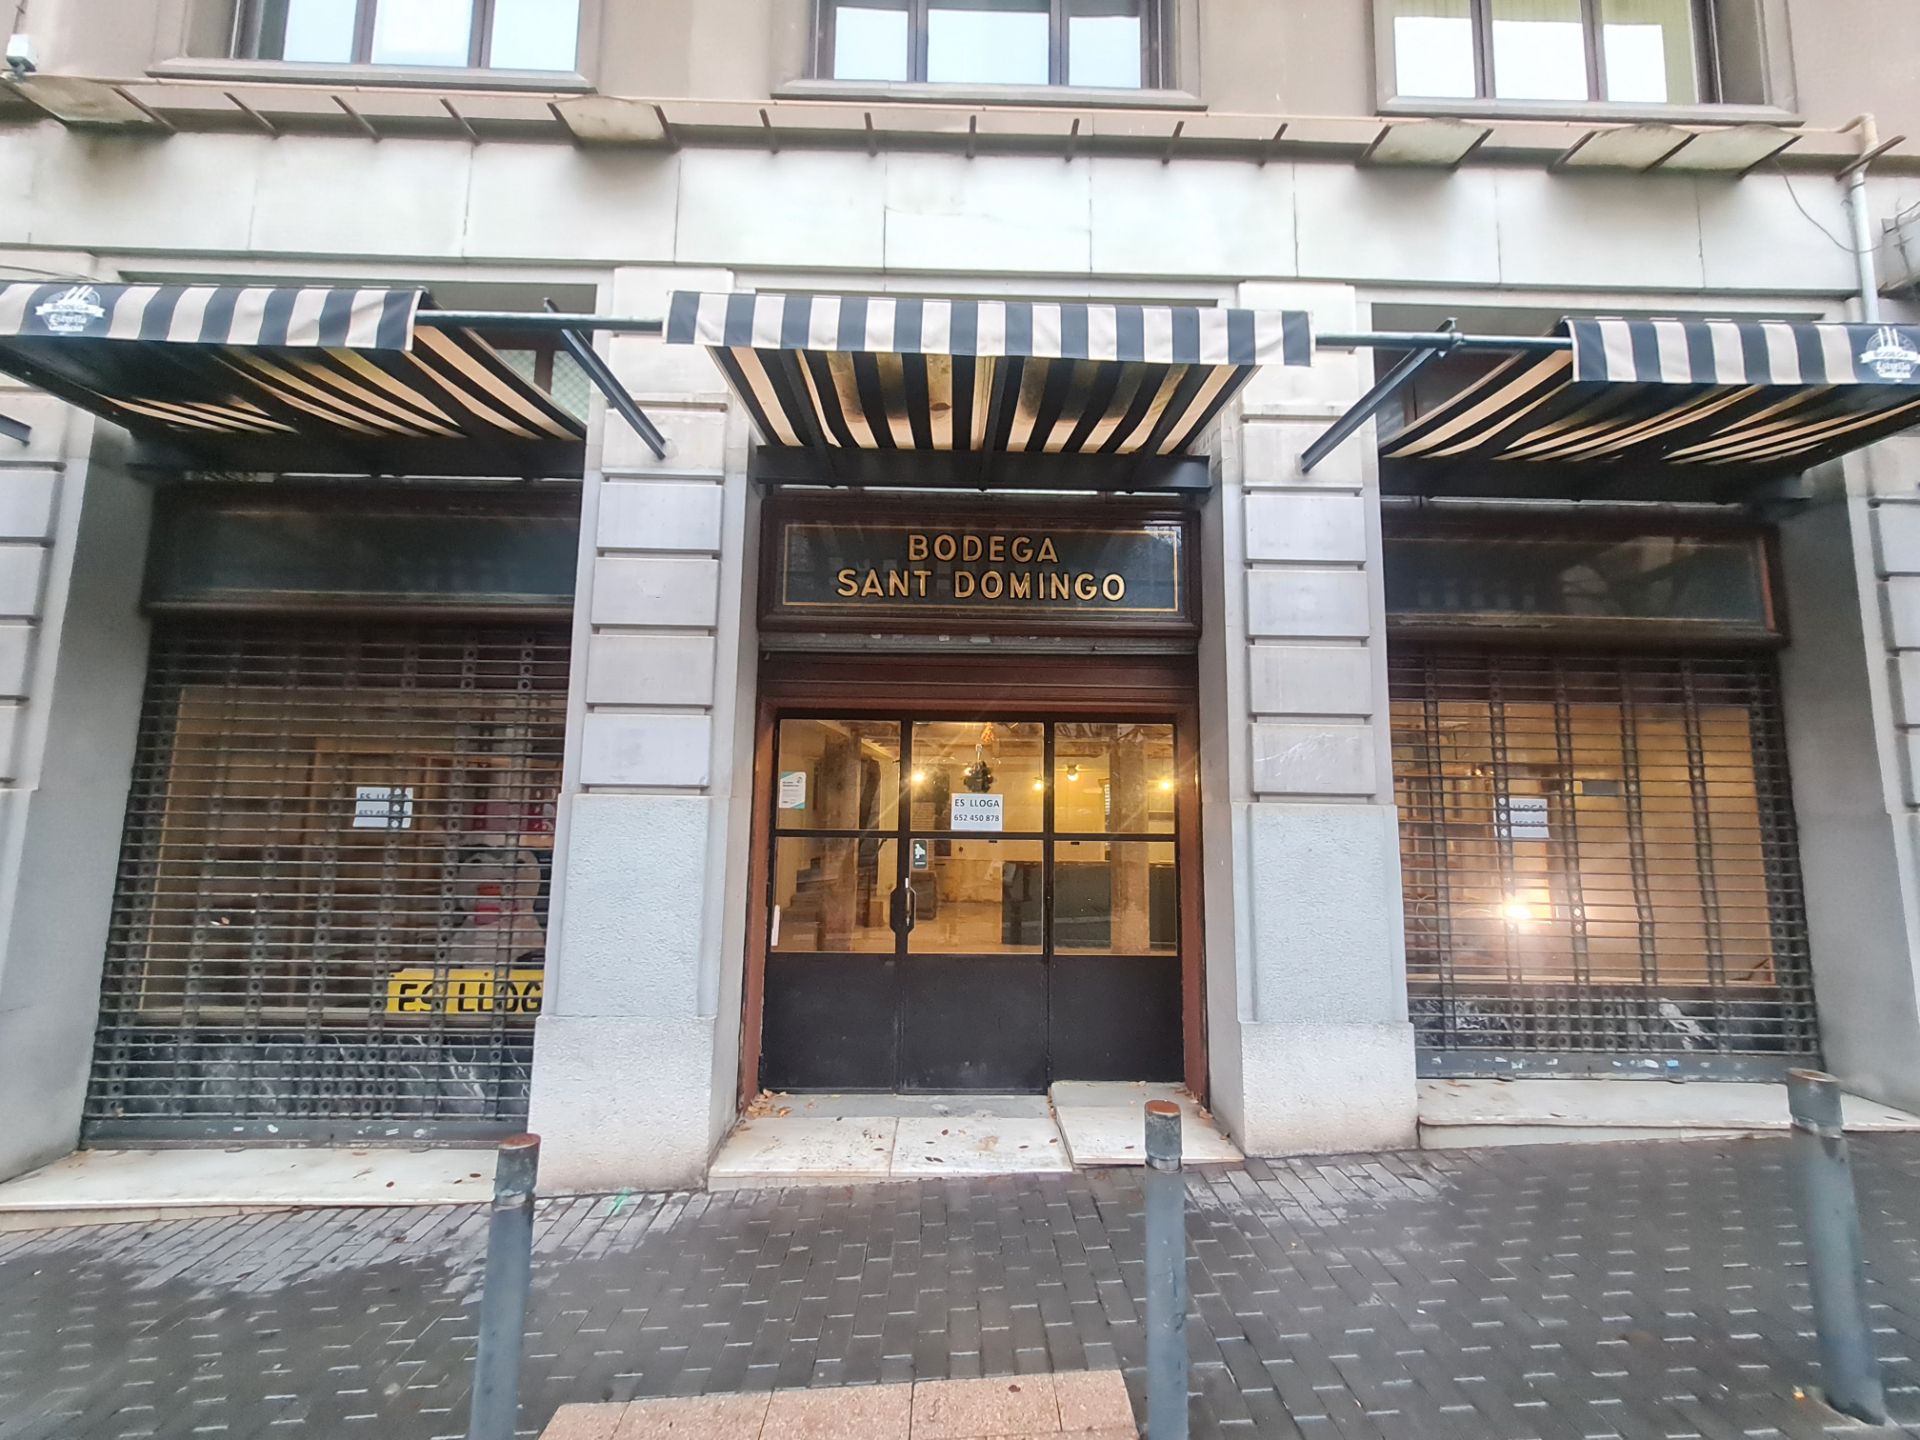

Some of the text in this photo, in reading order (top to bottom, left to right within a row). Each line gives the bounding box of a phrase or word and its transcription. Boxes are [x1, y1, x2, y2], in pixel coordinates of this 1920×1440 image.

[907, 534, 1059, 563] BODEGA
[836, 568, 1126, 601] SANT DOMINGO
[954, 799, 1000, 808] ES LLOGA
[969, 814, 984, 822] 450
[985, 814, 1000, 822] 878
